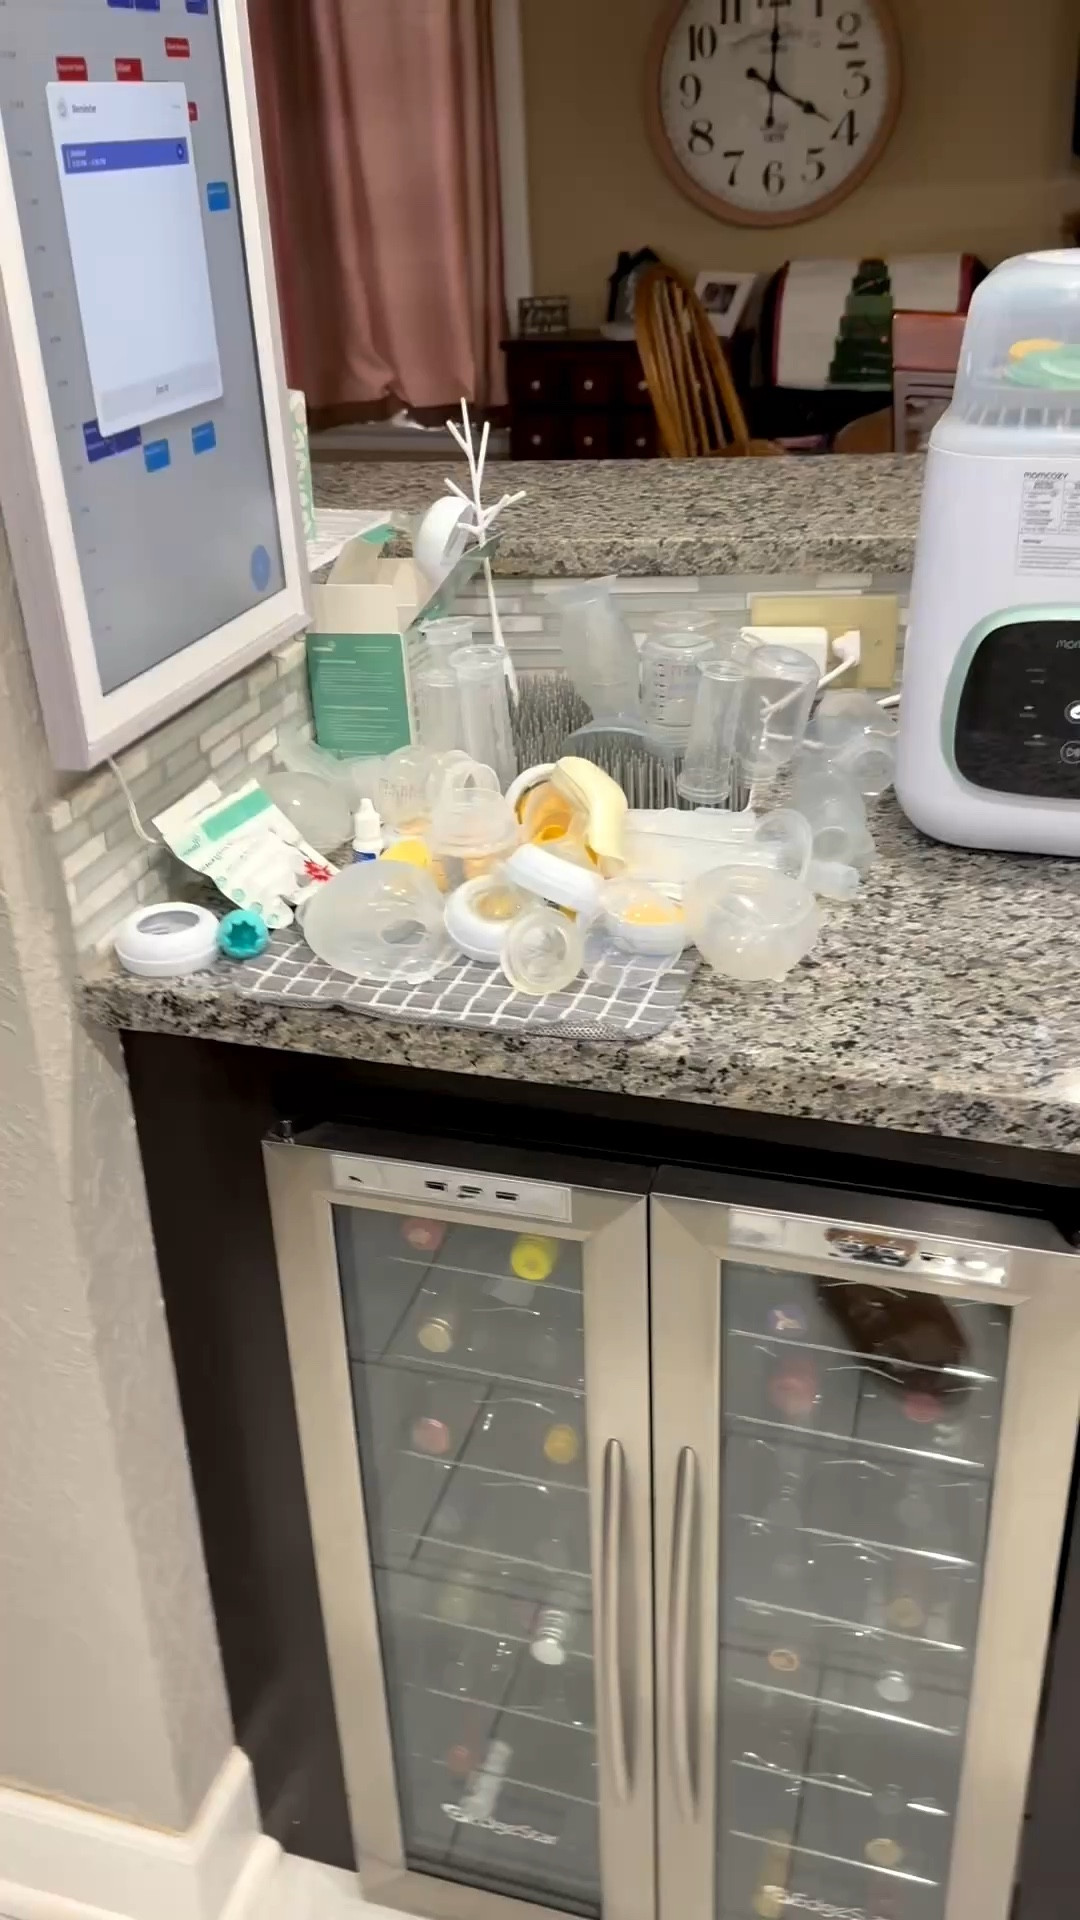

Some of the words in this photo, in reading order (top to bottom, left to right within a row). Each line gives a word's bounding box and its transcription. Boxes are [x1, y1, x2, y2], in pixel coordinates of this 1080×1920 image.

[688, 22, 718, 61] 10
[836, 11, 862, 50] 2
[679, 73, 702, 110] 9
[843, 59, 872, 100] 3
[687, 119, 715, 156] 8
[830, 109, 860, 146] 4
[723, 150, 745, 186] 7
[761, 160, 786, 196] 6
[801, 147, 826, 184] 5
